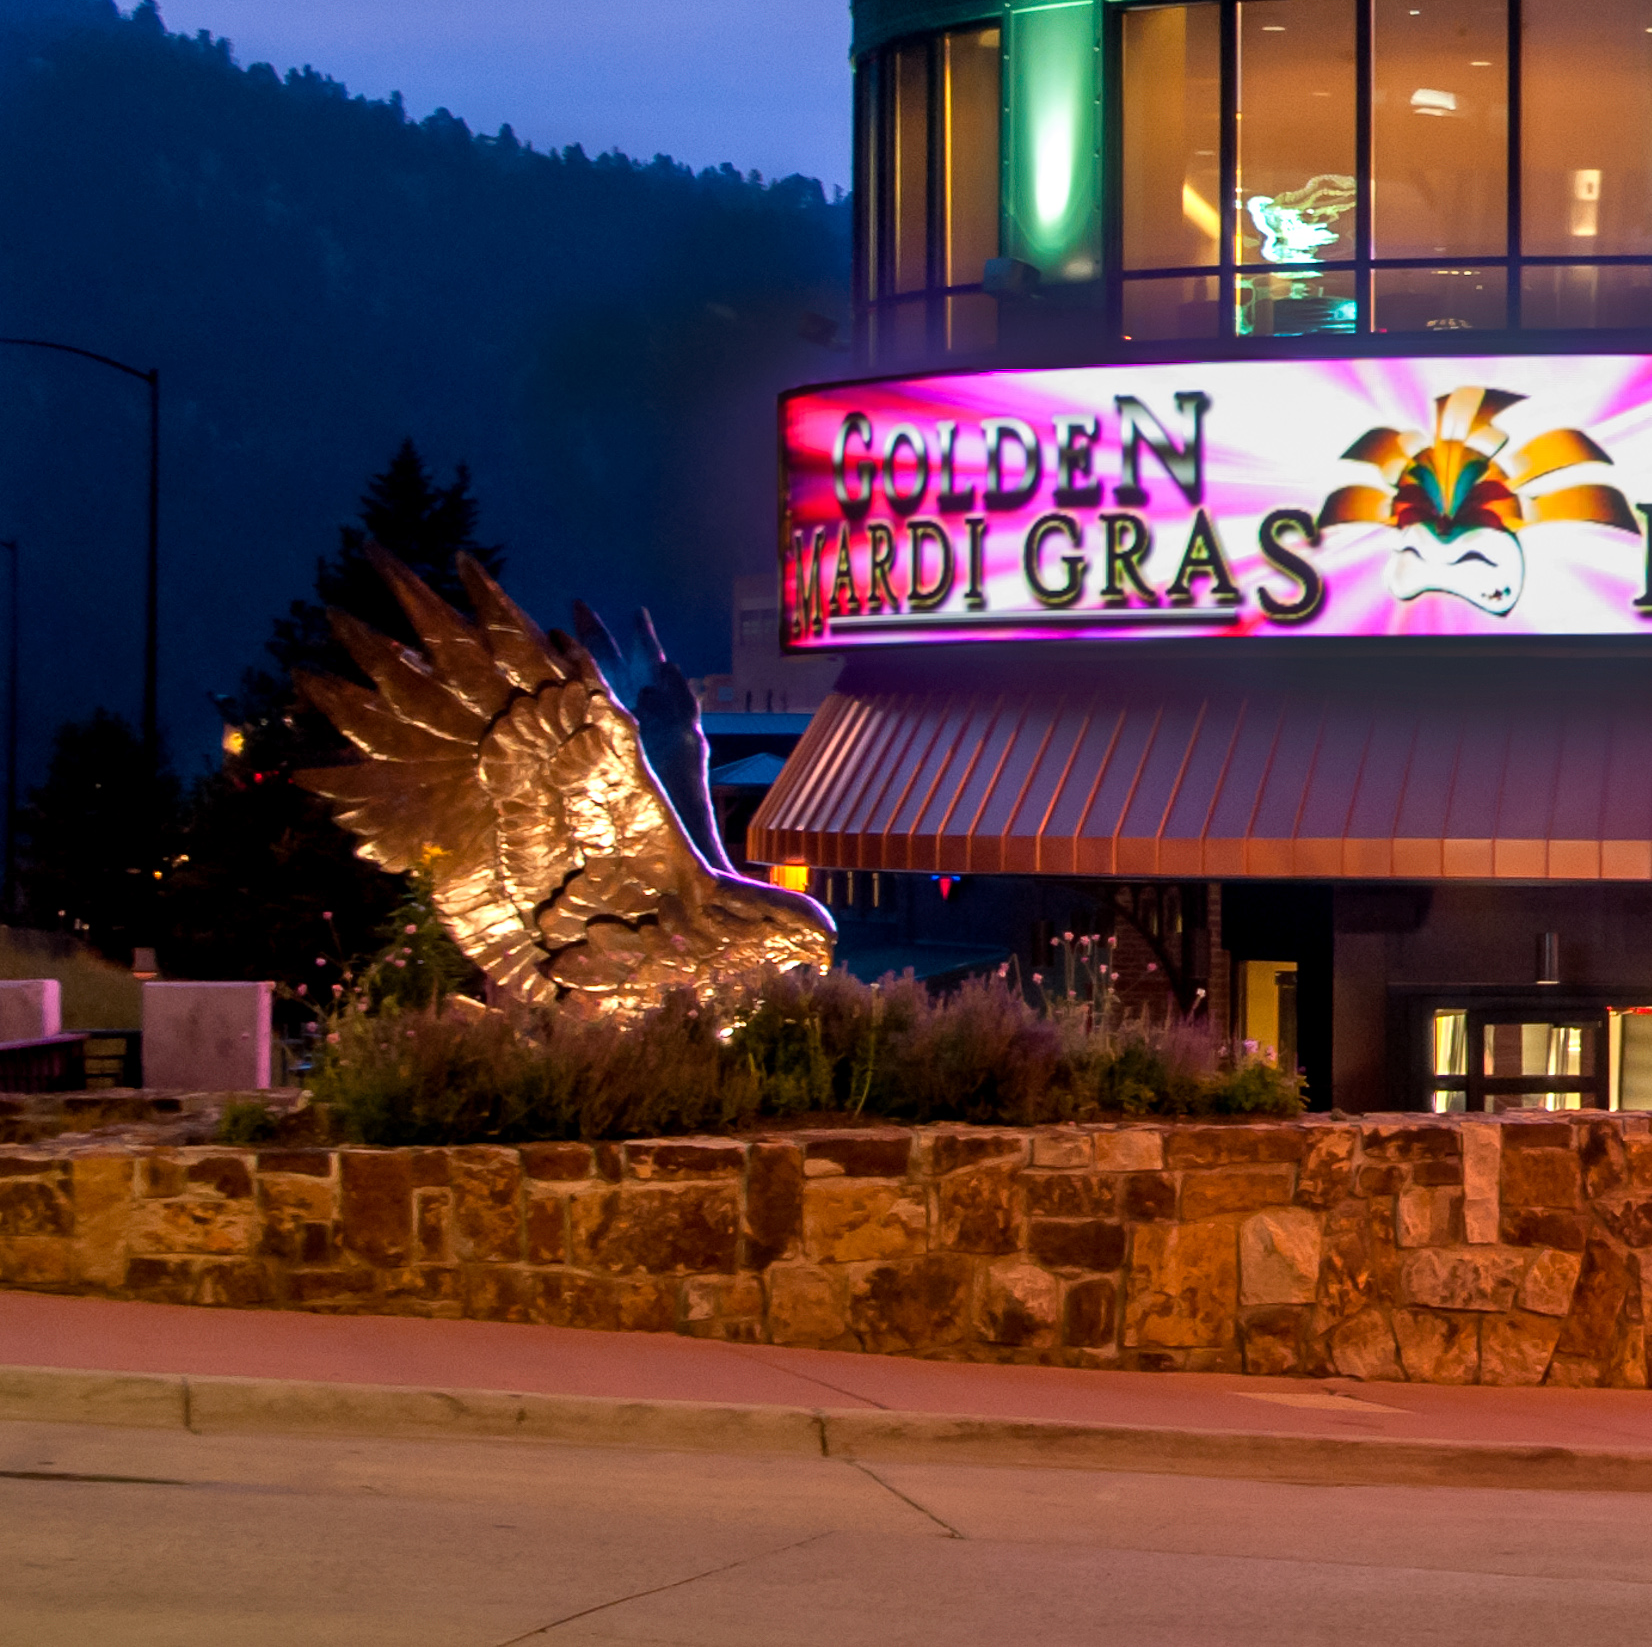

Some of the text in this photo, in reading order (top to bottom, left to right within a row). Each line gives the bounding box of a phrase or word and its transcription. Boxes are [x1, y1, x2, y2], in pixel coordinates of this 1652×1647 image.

[832, 390, 1212, 519] GOLDEN
[793, 507, 1325, 637] MARDI GRAS
